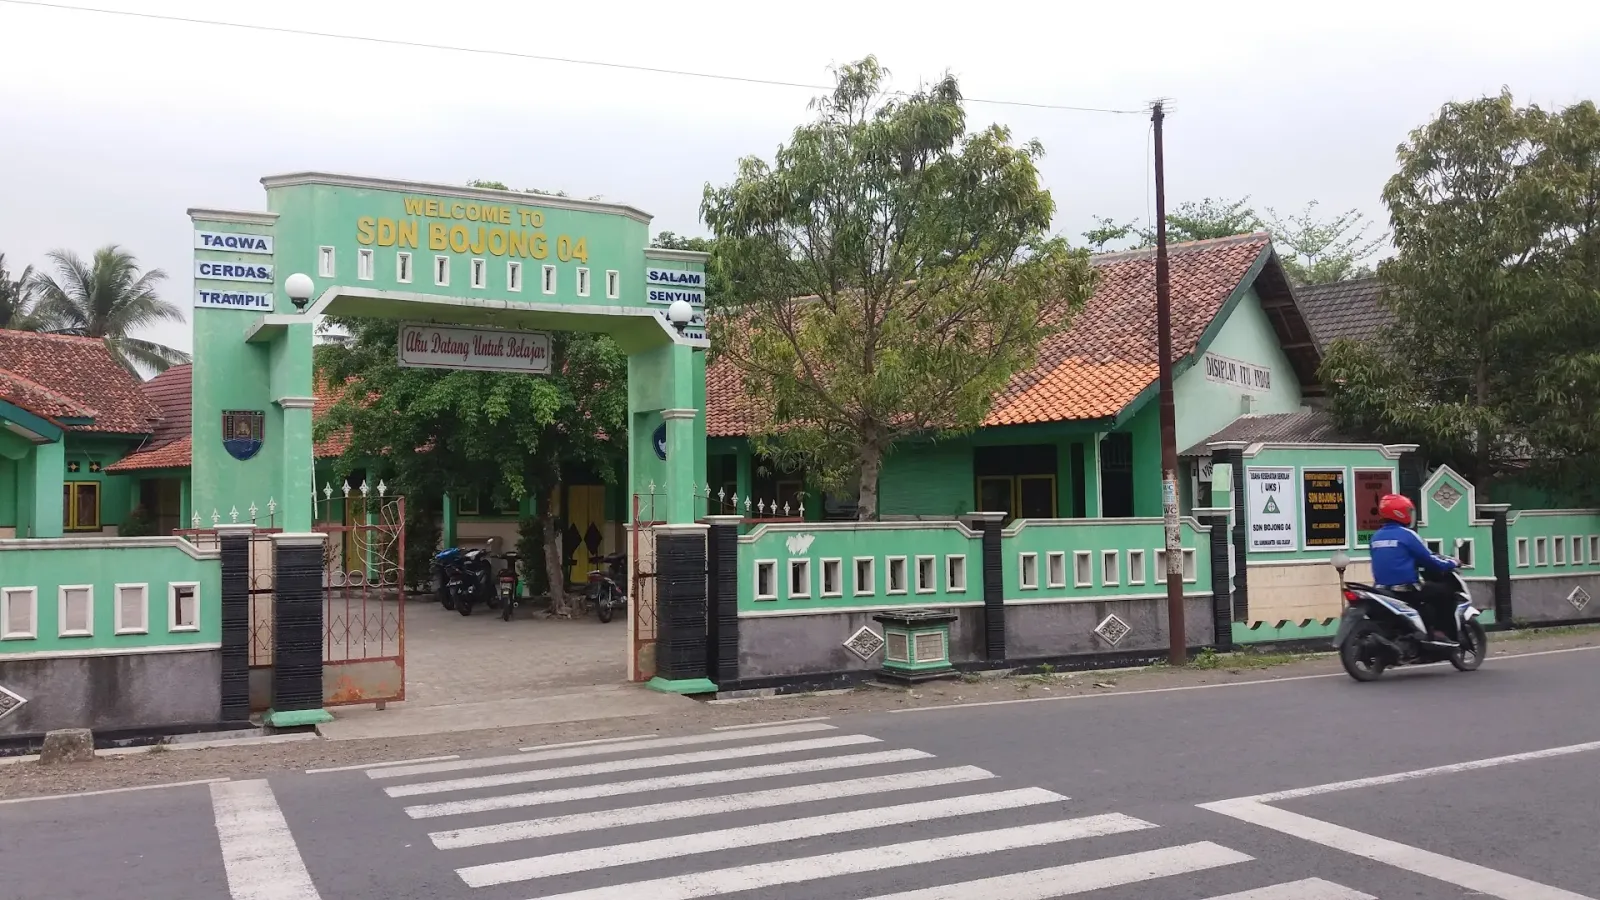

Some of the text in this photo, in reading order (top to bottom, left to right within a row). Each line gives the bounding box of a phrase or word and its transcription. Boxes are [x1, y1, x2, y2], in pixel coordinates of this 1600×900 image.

[404, 197, 545, 228] WELCOME TO
[201, 234, 268, 250] TAQWA
[356, 215, 588, 264] SDN BOJONG 04
[200, 263, 268, 279] CERDAS
[649, 271, 700, 284] SALAM
[199, 291, 270, 307] TRAMPIL
[649, 290, 702, 303] SENYUM
[405, 331, 546, 365] Aku Datang Untuk Belajar
[1239, 365, 1252, 386] ITU
[1308, 492, 1318, 504] SDN
[1318, 492, 1337, 504] BOJONG
[1252, 524, 1263, 532] SDN
[1285, 523, 1291, 531] 04
